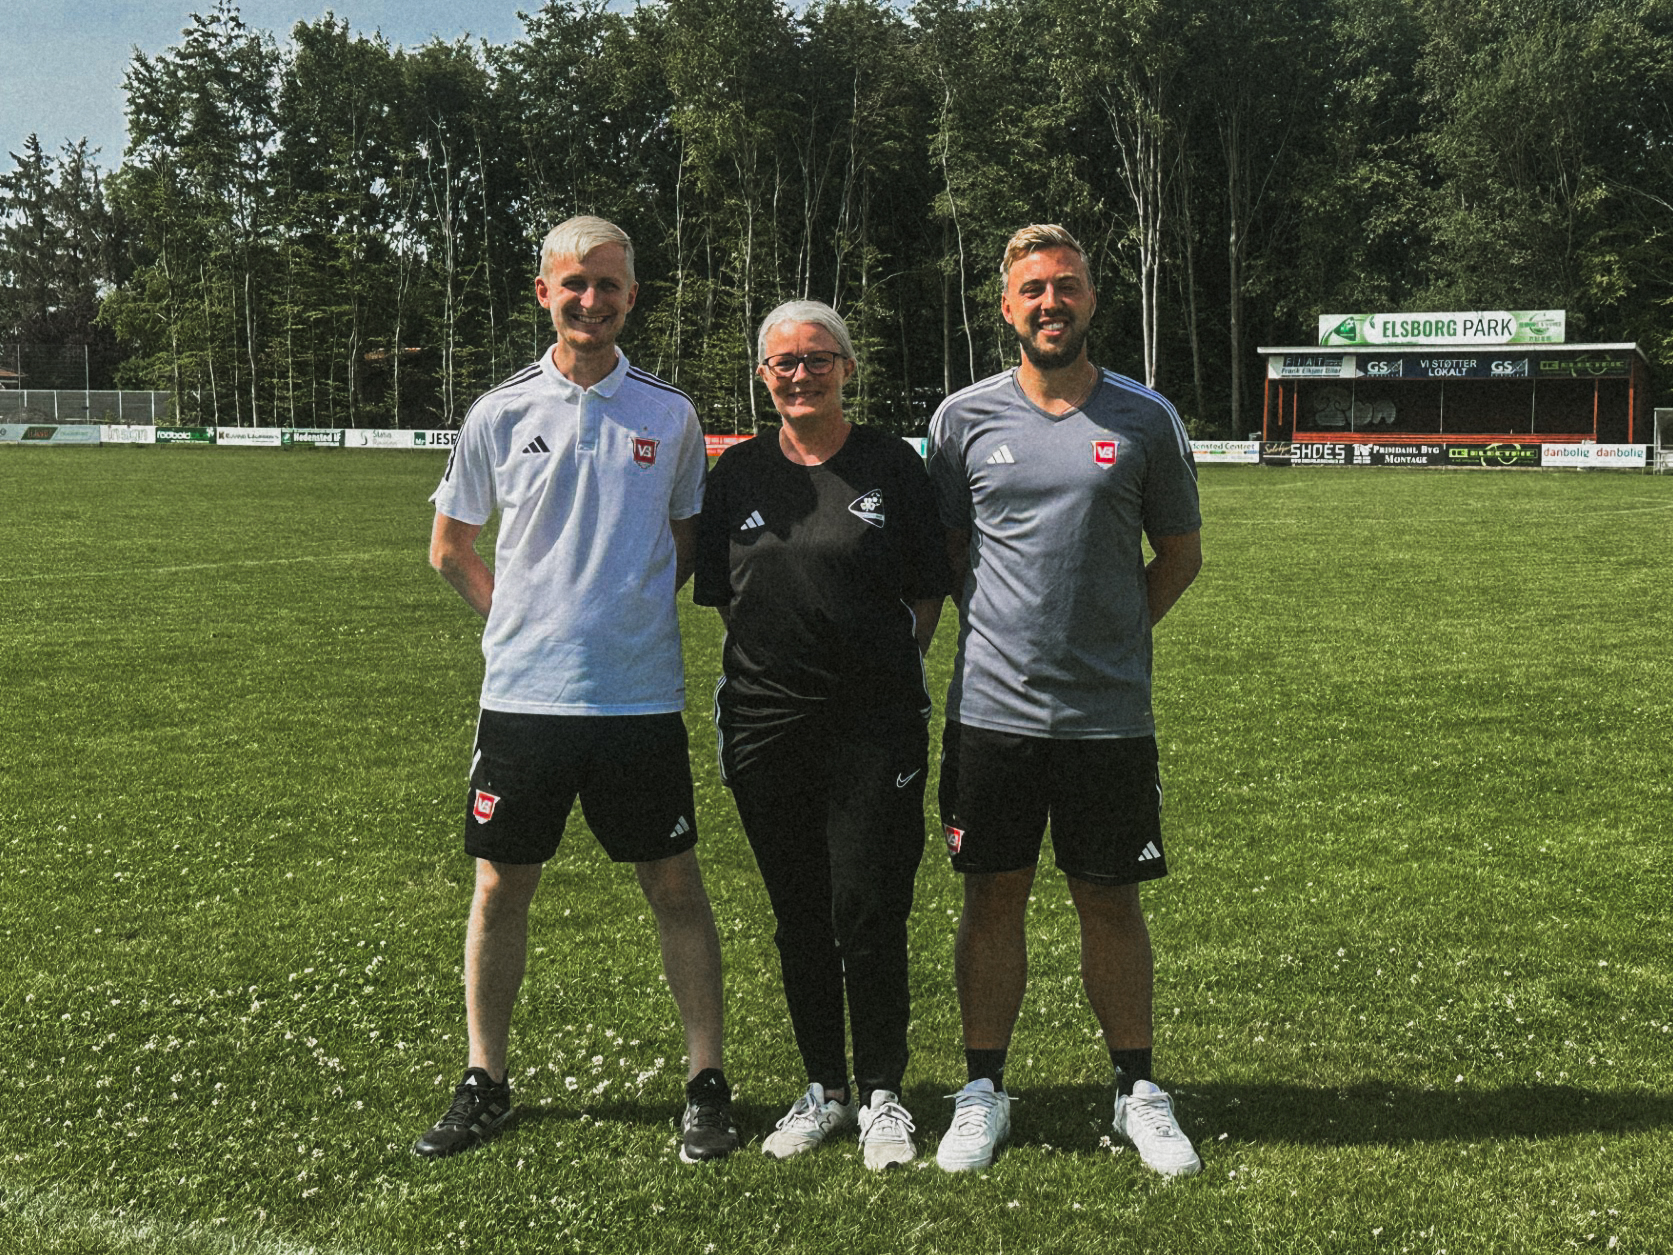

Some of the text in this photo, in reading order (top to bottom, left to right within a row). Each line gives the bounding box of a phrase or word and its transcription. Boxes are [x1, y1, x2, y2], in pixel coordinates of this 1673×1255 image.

[1382, 318, 1513, 338] ELSBORG PARK
[1420, 359, 1477, 368] VI STØTTER
[1491, 360, 1513, 371] GS
[1428, 367, 1467, 376] LOKALT
[1543, 447, 1644, 458] danbolig danbolig
